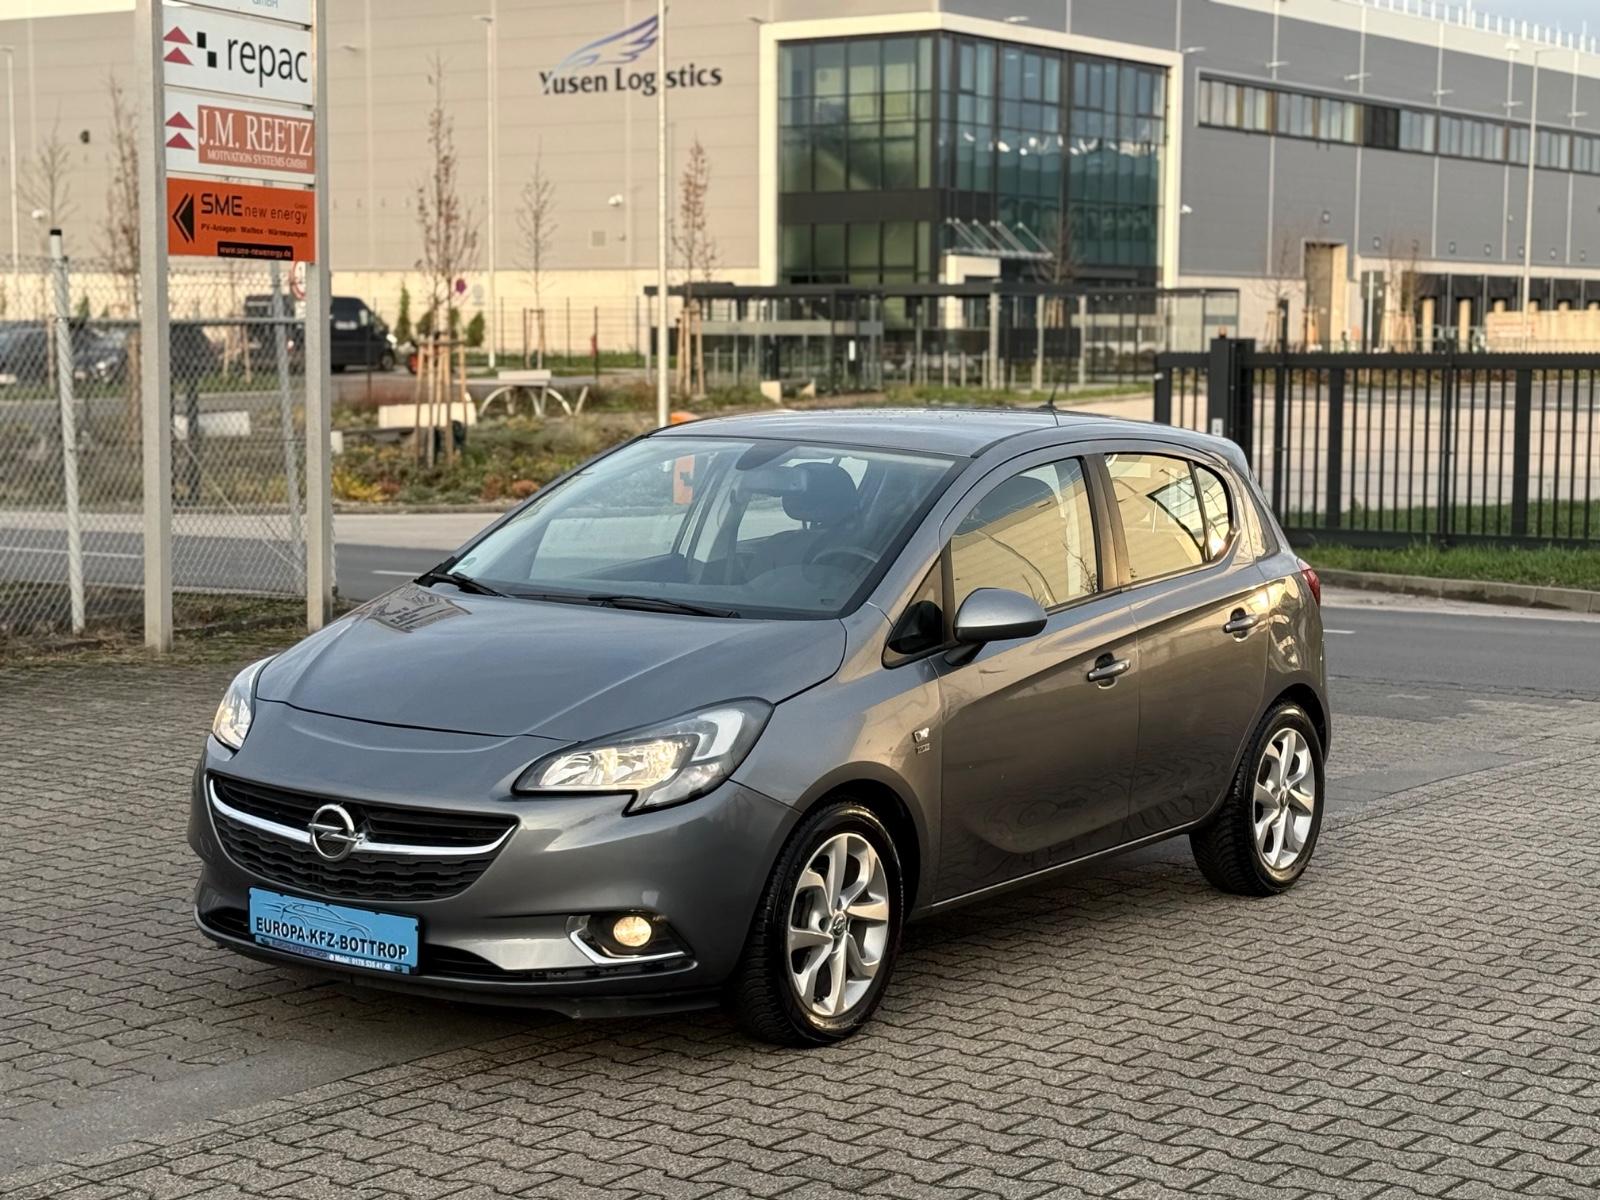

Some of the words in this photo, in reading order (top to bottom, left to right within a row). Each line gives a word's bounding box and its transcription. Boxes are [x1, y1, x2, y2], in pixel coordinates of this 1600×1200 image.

[227, 38, 308, 88] repac
[539, 71, 608, 95] Yusen
[615, 63, 722, 96] Logstics
[199, 109, 240, 149] J.M.
[245, 114, 312, 156] REETZ
[207, 149, 252, 164] MOTIVATION
[253, 154, 285, 167] SYSTEMS
[201, 193, 243, 216] SME
[244, 206, 267, 218] new
[271, 207, 308, 224] energy
